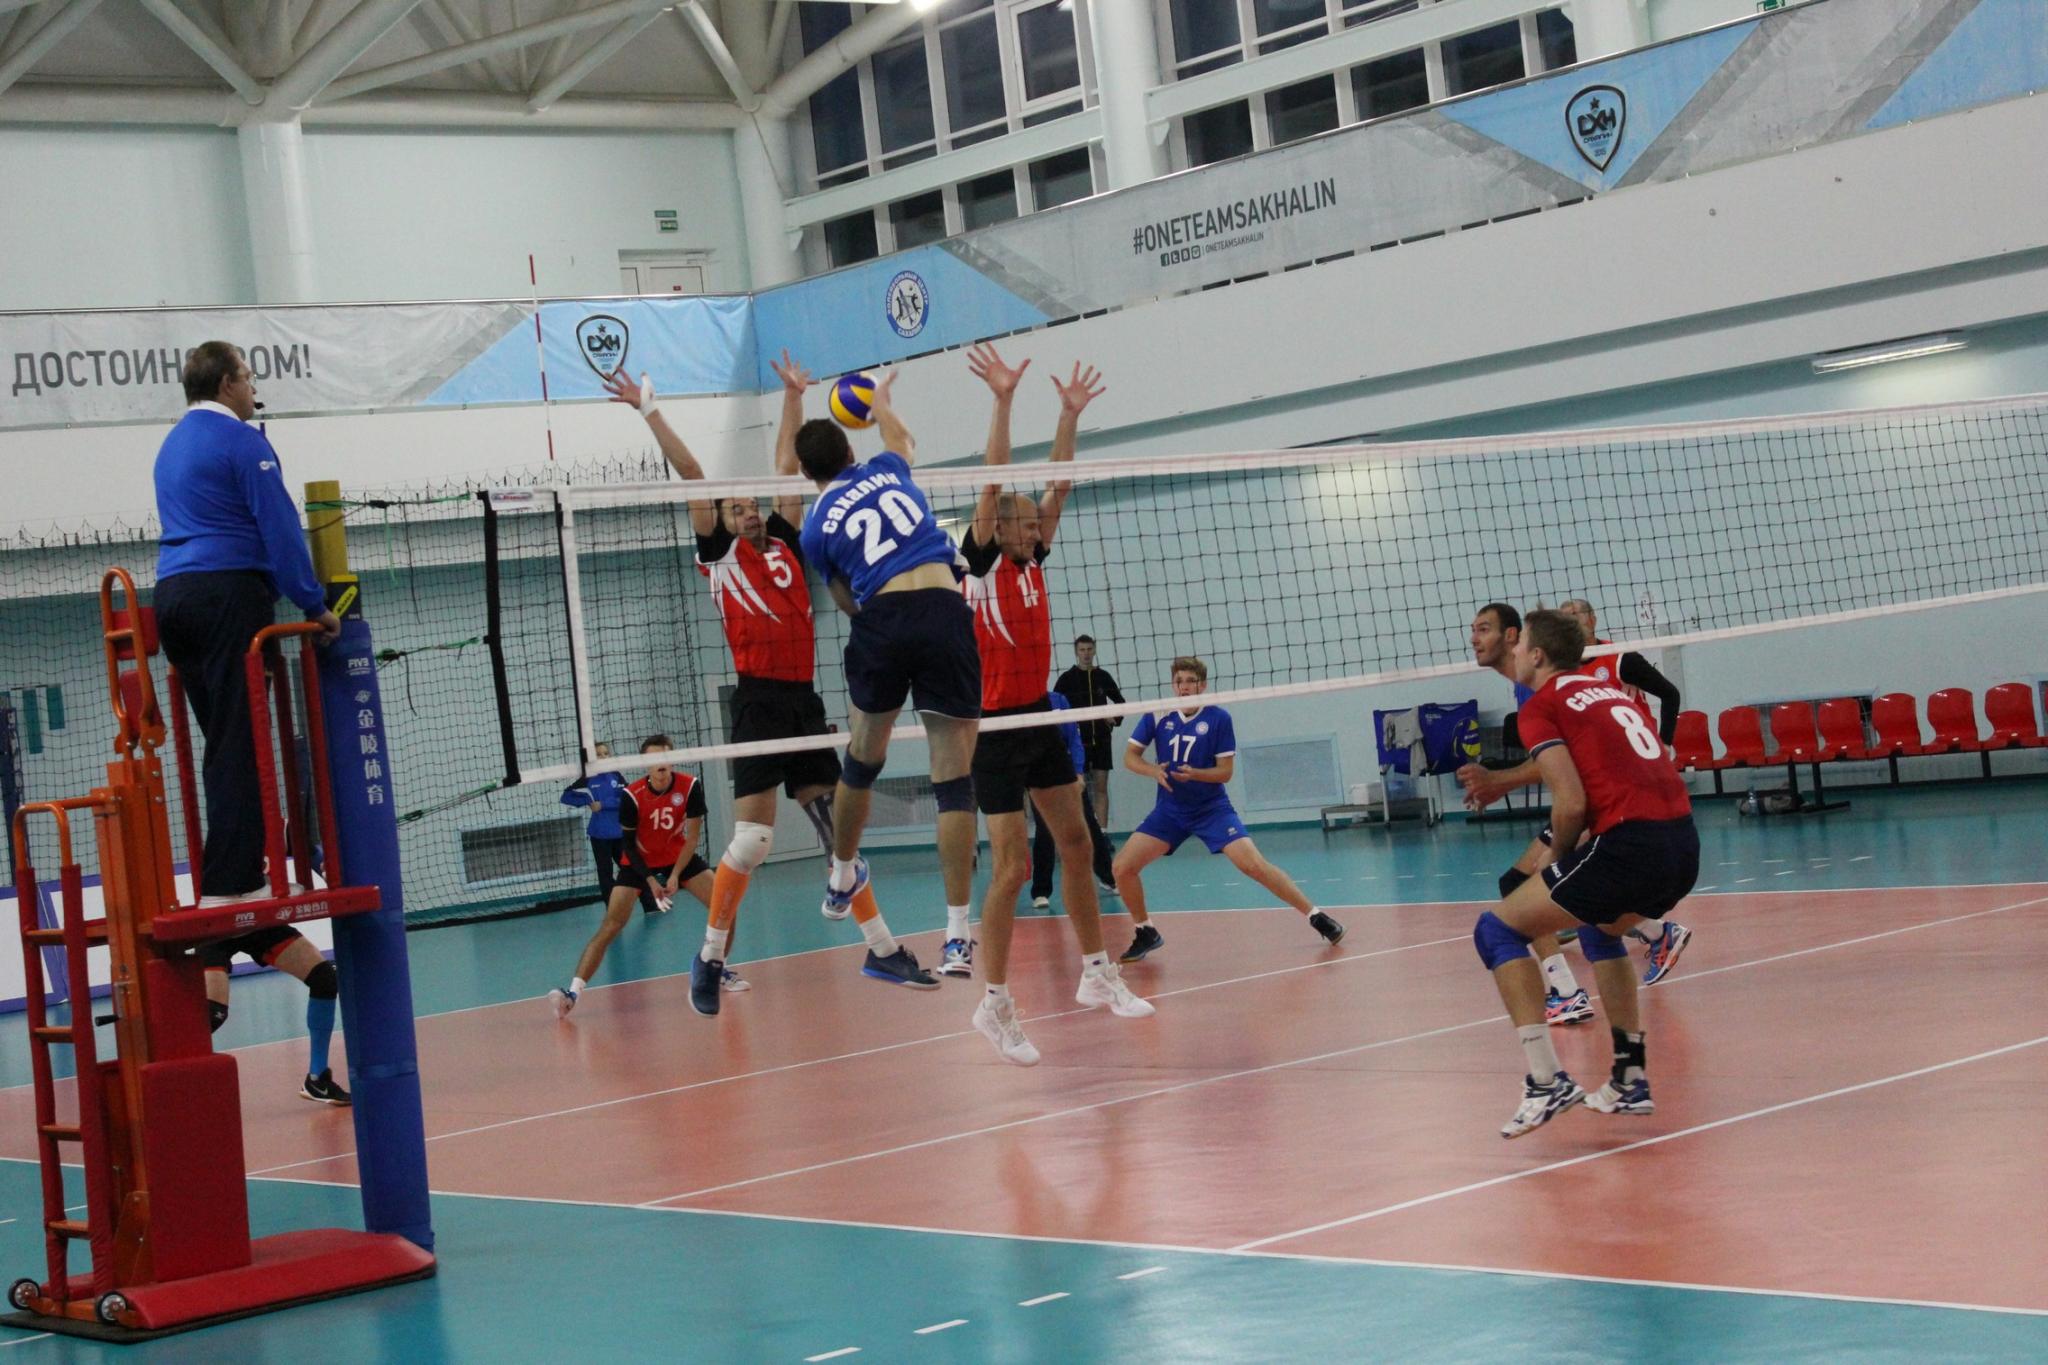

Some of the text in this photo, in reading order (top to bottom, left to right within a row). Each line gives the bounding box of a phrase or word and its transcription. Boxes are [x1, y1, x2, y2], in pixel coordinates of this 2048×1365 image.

[1132, 177, 1337, 255] #ONETEAMSAKHALIN
[1205, 231, 1264, 254] ONETEAMSAKHALIN
[12, 343, 312, 397] ДОСТОИНОМ!
[845, 489, 924, 566] 20
[763, 551, 792, 588] 5
[347, 658, 369, 668] FIVB
[1168, 734, 1197, 763] 17
[1610, 705, 1661, 760] 8
[357, 708, 384, 805] 金陵体育
[649, 807, 674, 831] 15
